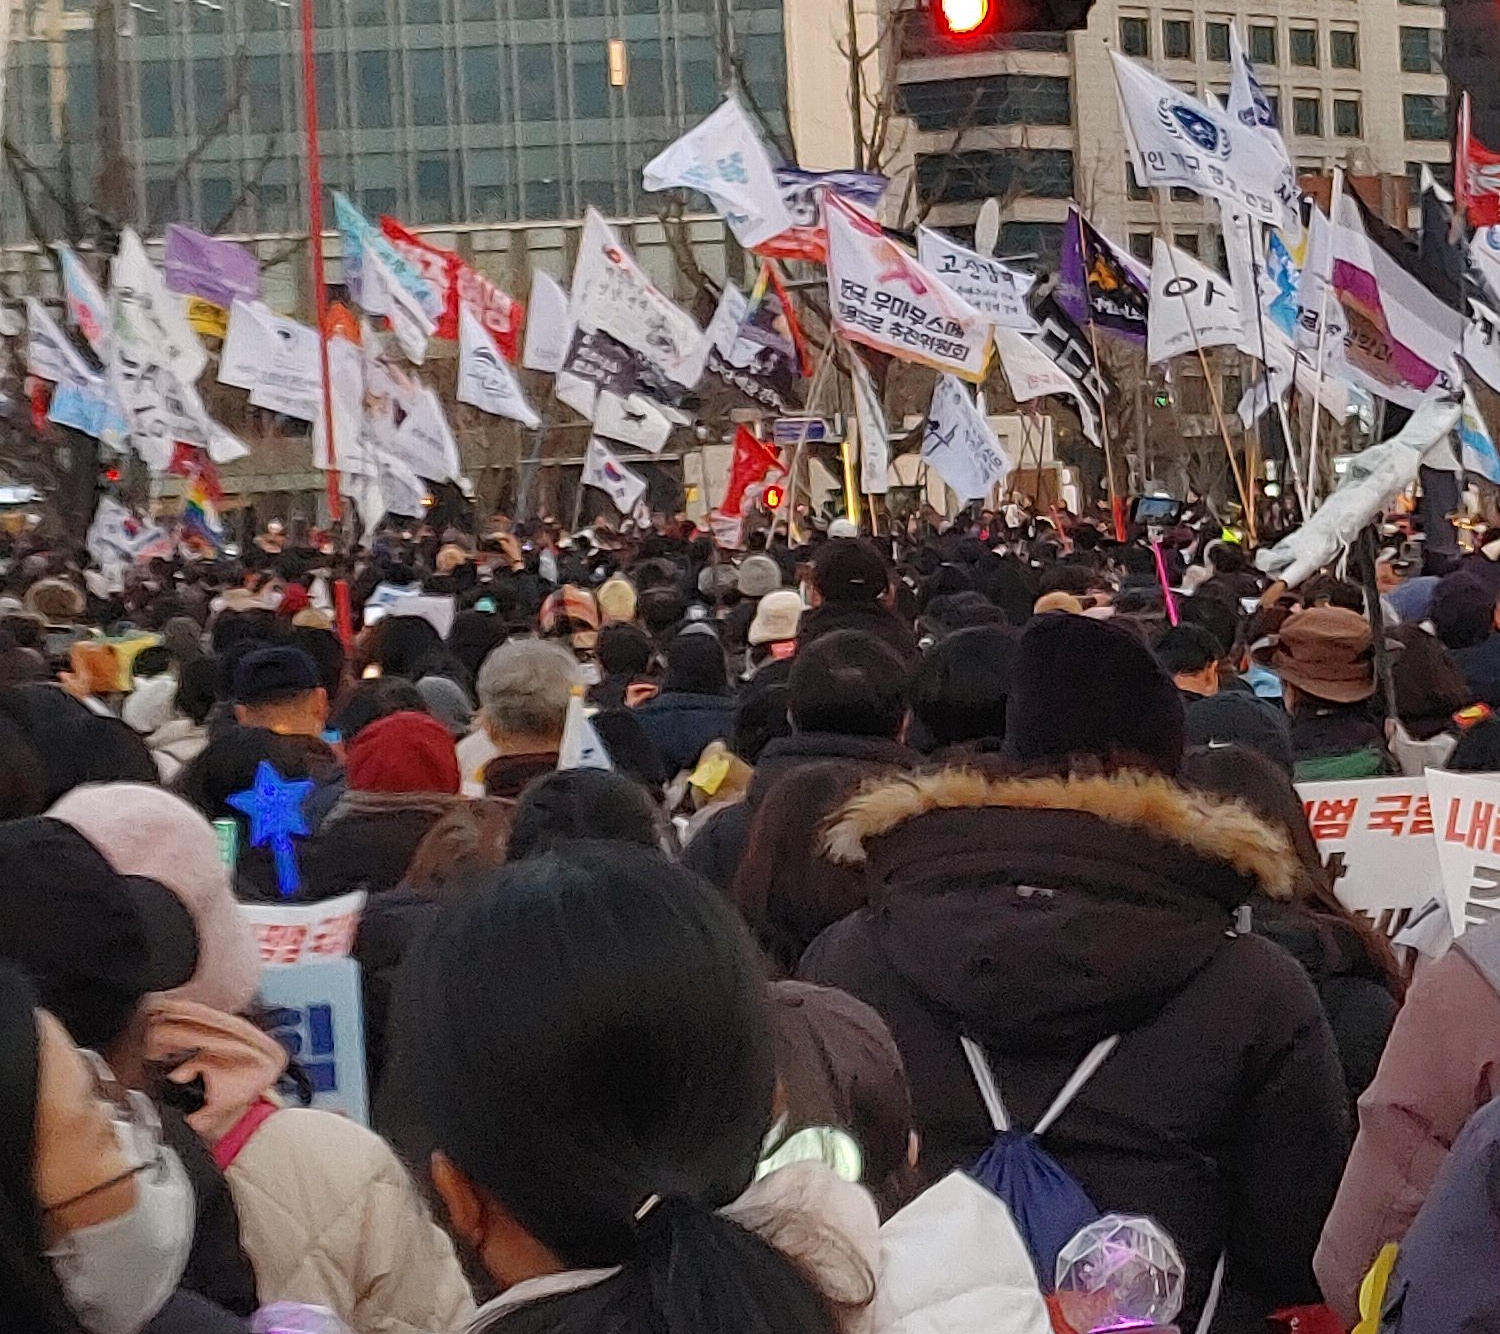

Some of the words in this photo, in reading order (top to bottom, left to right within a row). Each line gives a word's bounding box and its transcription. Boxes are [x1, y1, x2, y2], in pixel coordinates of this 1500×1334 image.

[871, 290, 966, 339] 우마무스메
[888, 321, 970, 363] 추진위원회
[1303, 797, 1359, 841] 범
